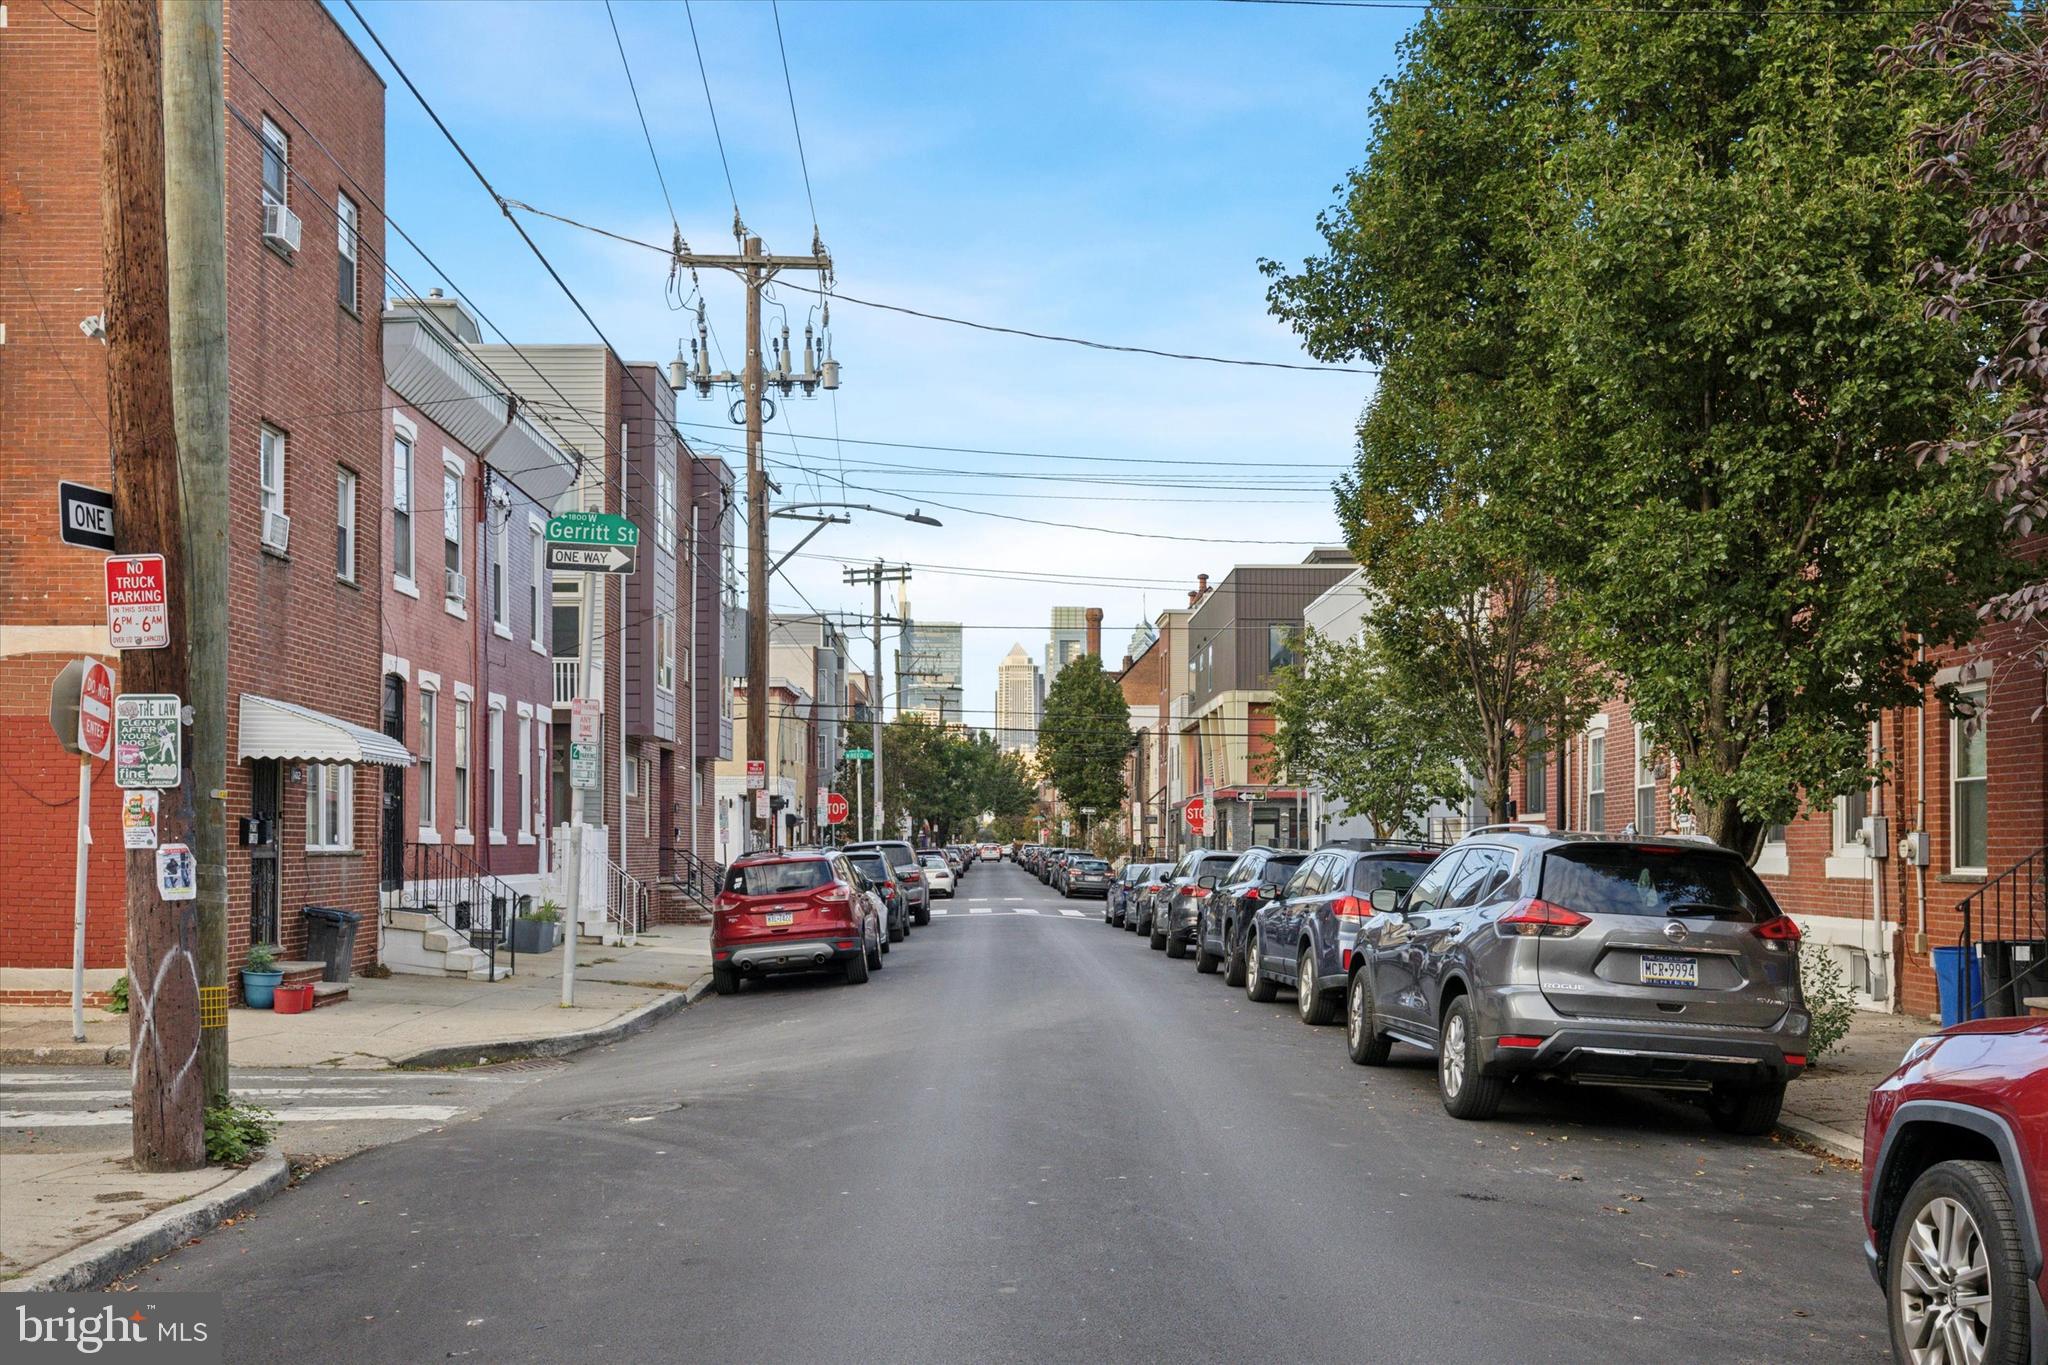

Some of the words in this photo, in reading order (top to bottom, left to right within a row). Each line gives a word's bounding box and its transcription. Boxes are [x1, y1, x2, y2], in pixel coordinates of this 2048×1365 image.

[75, 504, 107, 532] ONE
[568, 513, 588, 521] 1800
[588, 514, 598, 523] W
[550, 522, 611, 541] Gerritt
[617, 526, 635, 543] St
[555, 551, 580, 563] ONE
[584, 552, 609, 564] WAY
[126, 562, 144, 575] NO
[116, 576, 156, 589] TRUCK
[111, 590, 162, 604] PARKING
[121, 605, 136, 613] THIS
[137, 605, 161, 613] STREET
[87, 677, 97, 694] DO
[97, 683, 110, 701] NOT
[139, 703, 155, 717] THE
[159, 703, 178, 717] LAW
[86, 719, 105, 739] ENTER
[160, 719, 176, 727] UP
[119, 768, 146, 780] fine
[828, 802, 847, 815] TOP
[1187, 807, 1204, 820] STO
[1543, 982, 1585, 991] ROGUE
